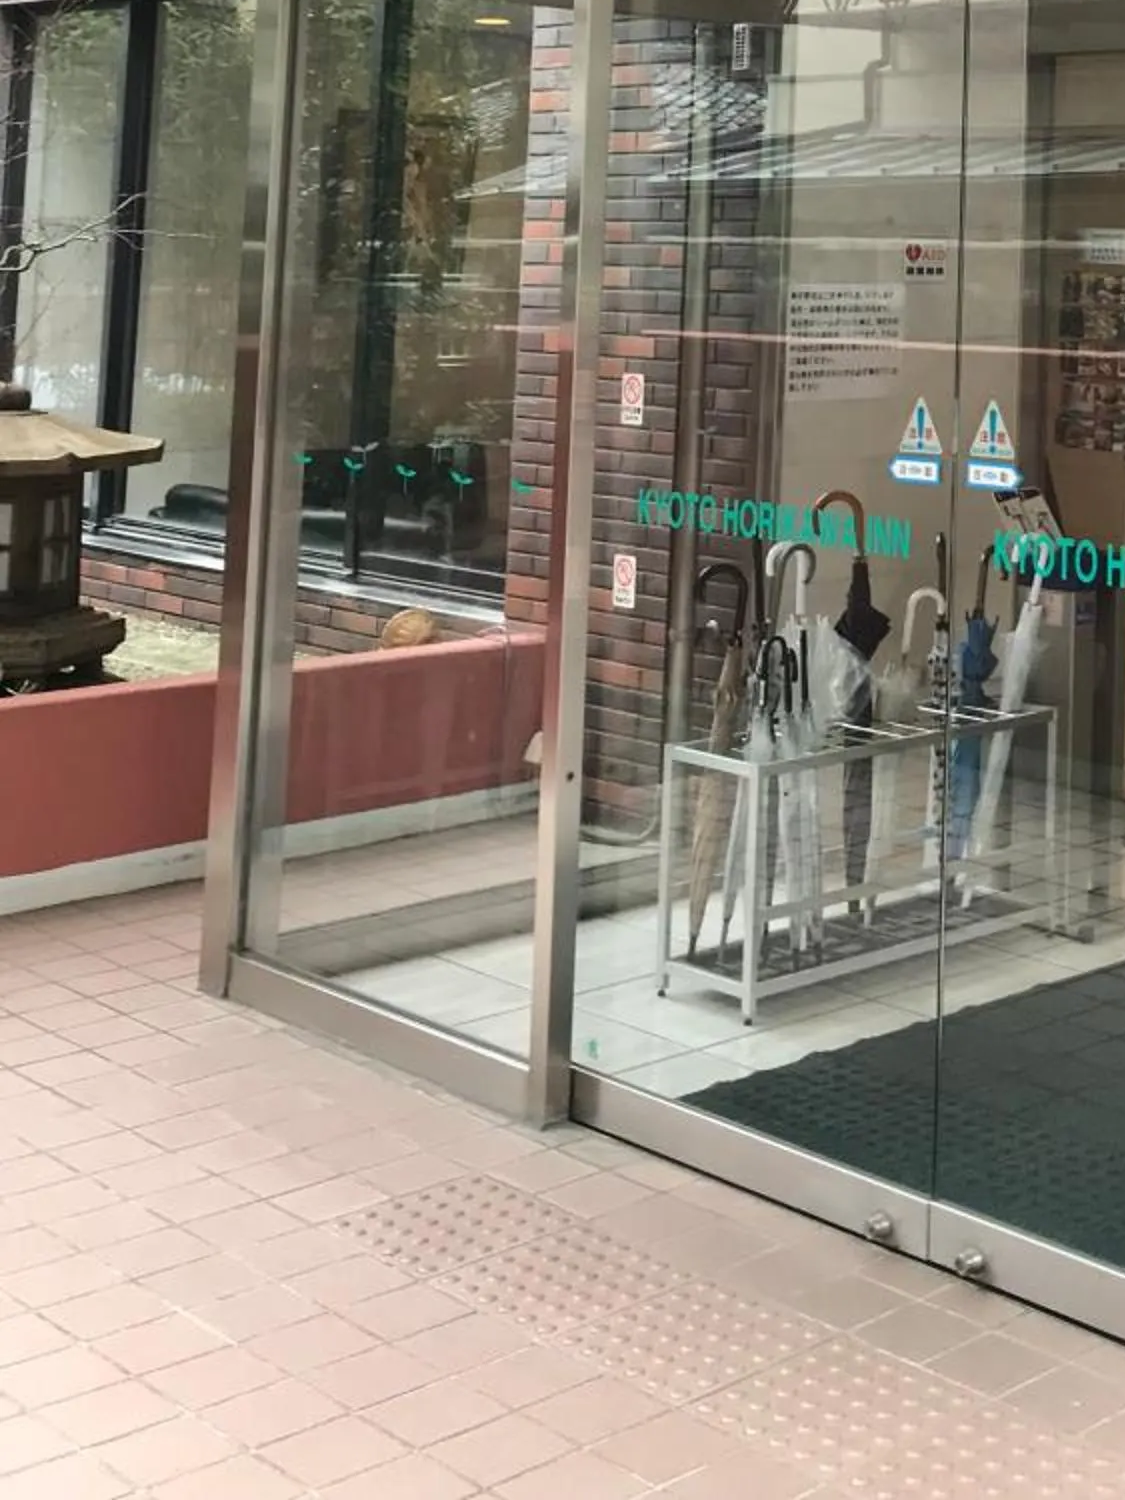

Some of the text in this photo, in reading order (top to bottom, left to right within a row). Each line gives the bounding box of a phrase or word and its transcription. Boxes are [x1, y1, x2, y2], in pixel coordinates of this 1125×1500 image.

[636, 488, 717, 533] KYOTO
[866, 514, 912, 560] INN
[992, 528, 1100, 584] KYOTO
